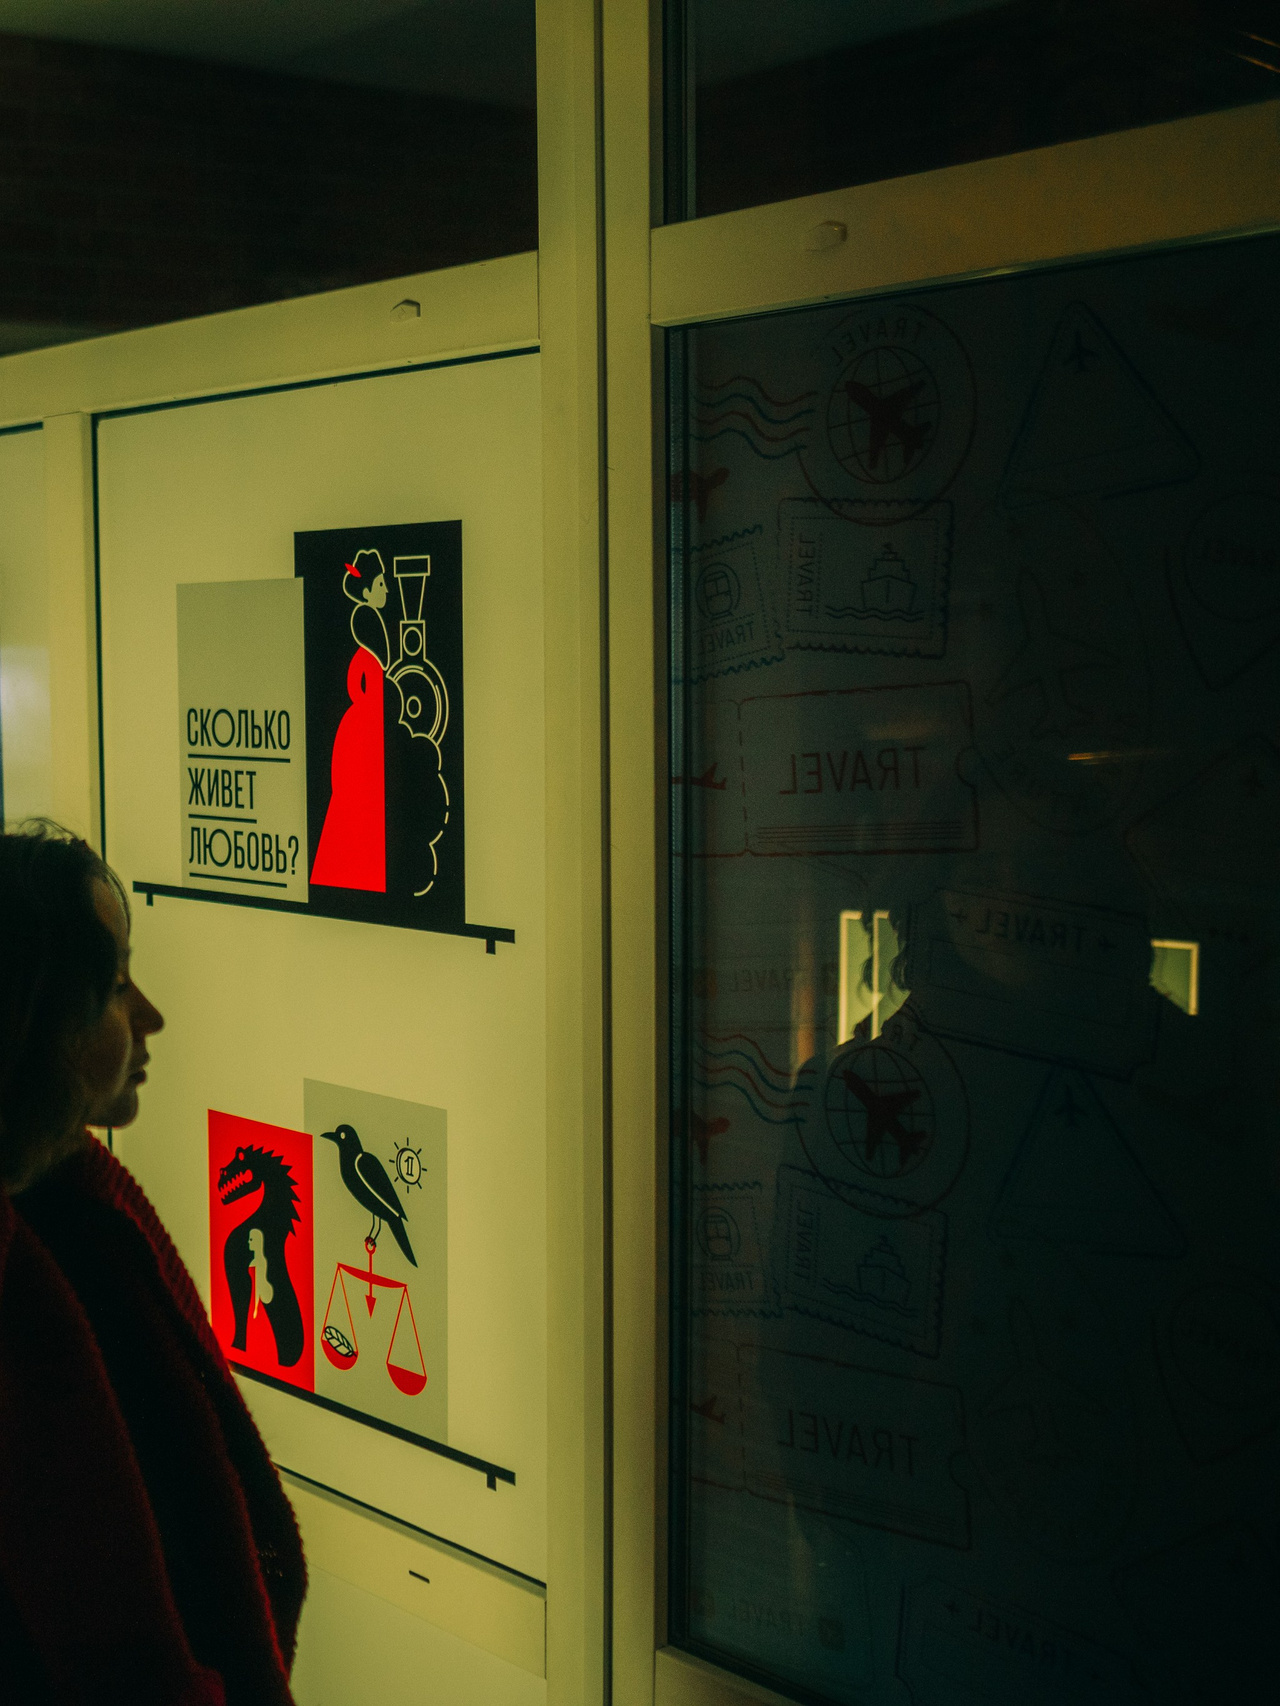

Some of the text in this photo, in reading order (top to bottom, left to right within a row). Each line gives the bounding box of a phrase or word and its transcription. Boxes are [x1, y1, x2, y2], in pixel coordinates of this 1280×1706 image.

[186, 707, 292, 751] СКОЛЬКО
[187, 767, 258, 810] ЖИВЕТ
[188, 826, 300, 875] ЛЮБОВЬ?
